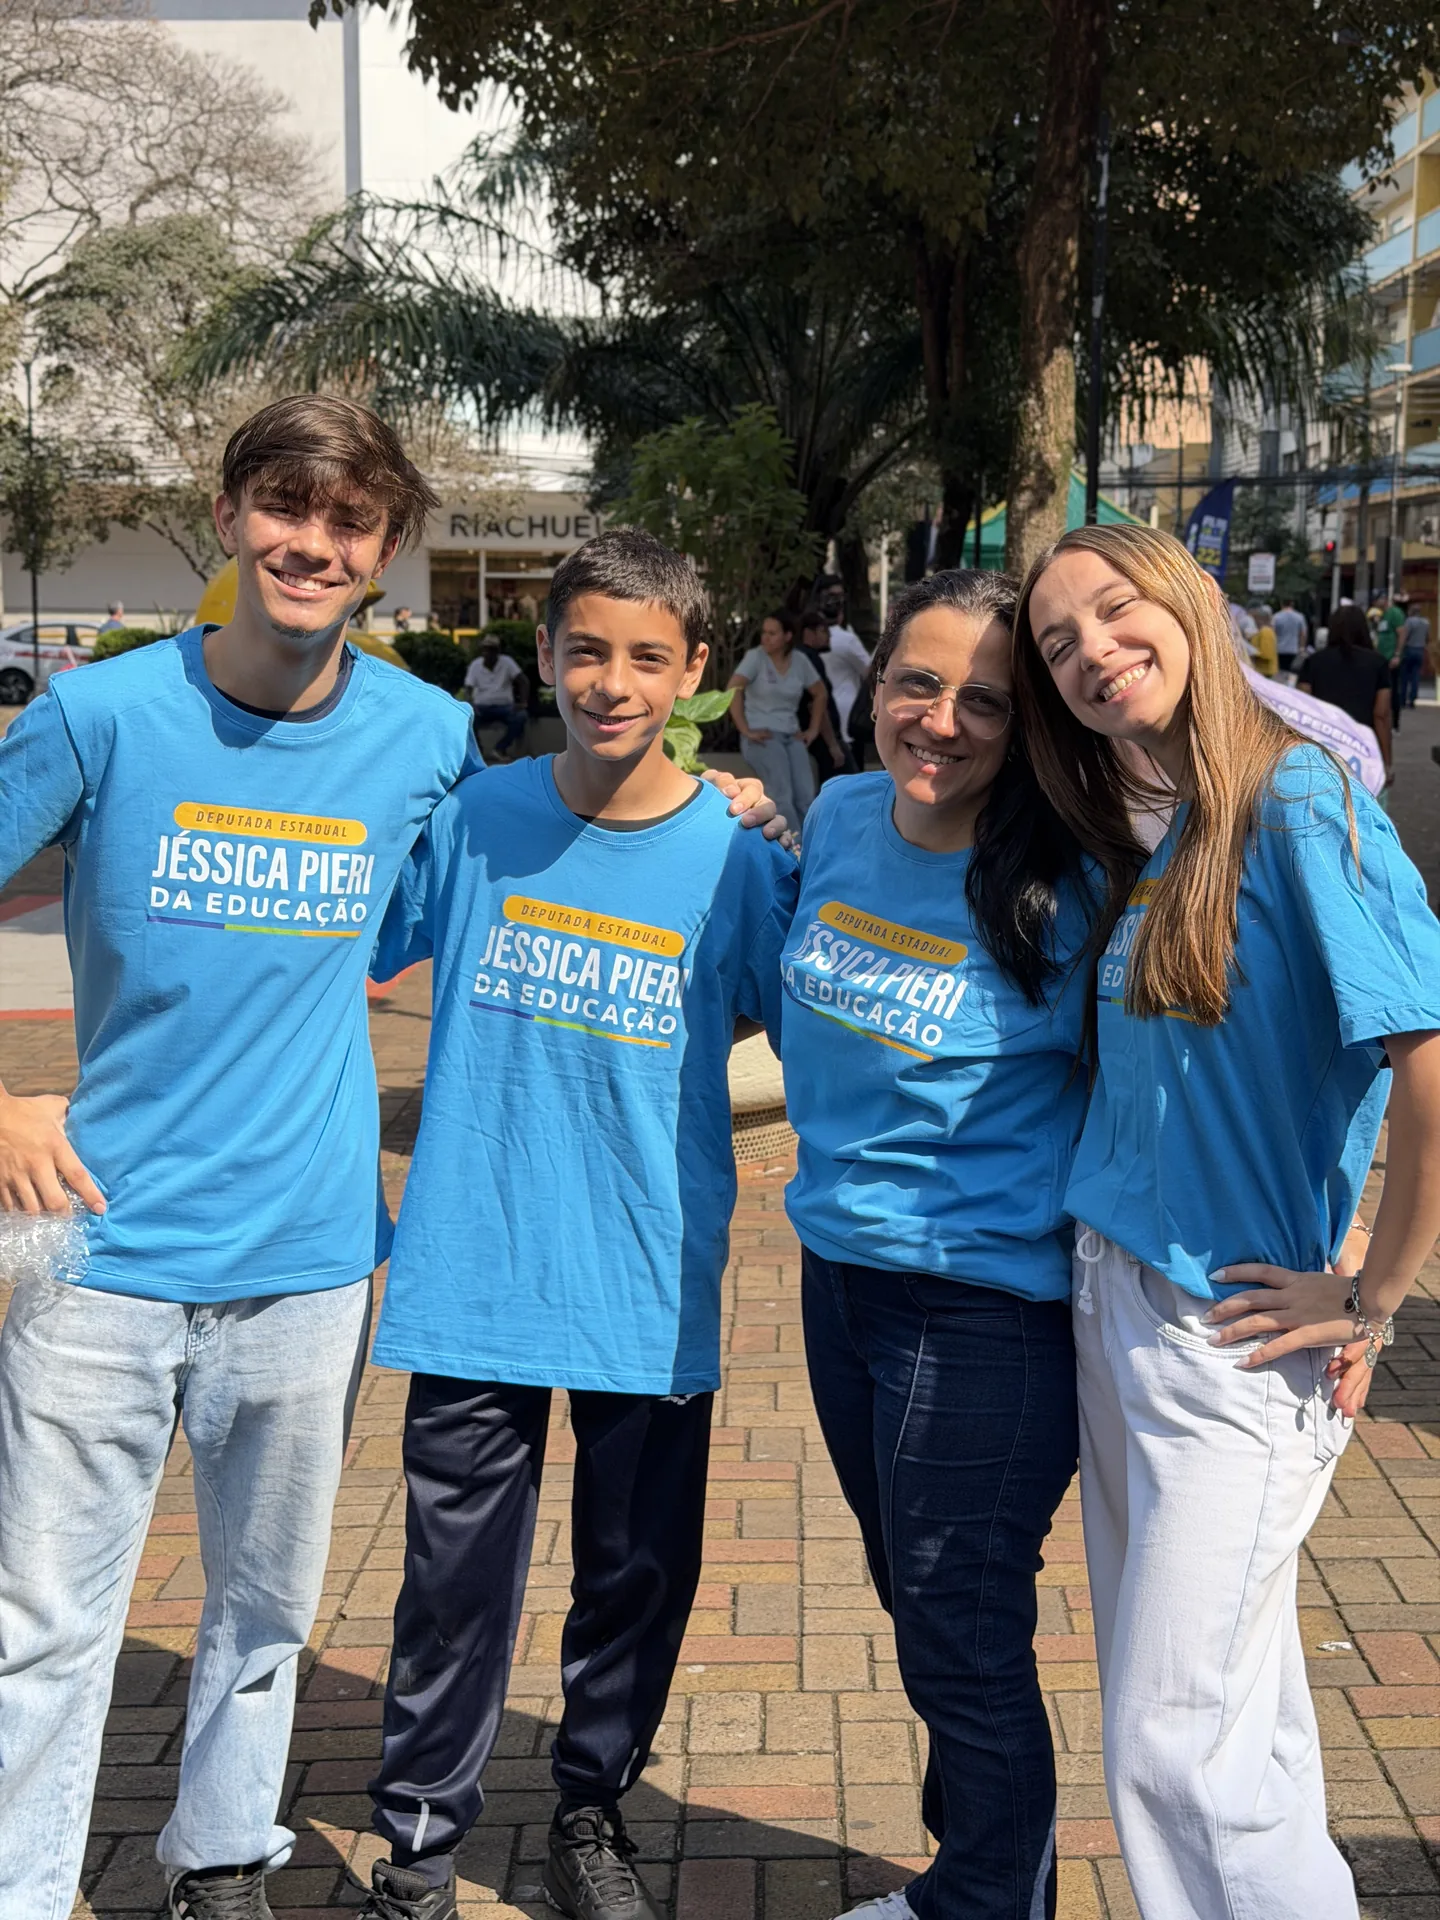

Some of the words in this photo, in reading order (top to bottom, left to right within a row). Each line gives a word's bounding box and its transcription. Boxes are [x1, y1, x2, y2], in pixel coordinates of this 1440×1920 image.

[195, 810, 272, 830] DEPUTADA
[279, 819, 348, 838] ESTADUAL
[151, 830, 289, 891] JÉSSICA
[298, 850, 376, 895] PIERI
[150, 886, 192, 911] DA
[206, 892, 368, 927] EDUCAÇÃO
[520, 904, 591, 930] DEPUTADA
[597, 921, 667, 948] ESTADUAL
[834, 911, 888, 939] DEPUTADA
[891, 932, 952, 958] ESTADUAL
[479, 922, 601, 991] JÉSSICA
[608, 953, 690, 1008] PIERI
[787, 921, 891, 990] ÉSSICA
[878, 963, 969, 1021] PIERI
[473, 973, 511, 1000] DA
[520, 983, 678, 1035] EDUCAÇÃO
[780, 960, 796, 989] A
[804, 977, 943, 1047] EDUCAÇÃO
